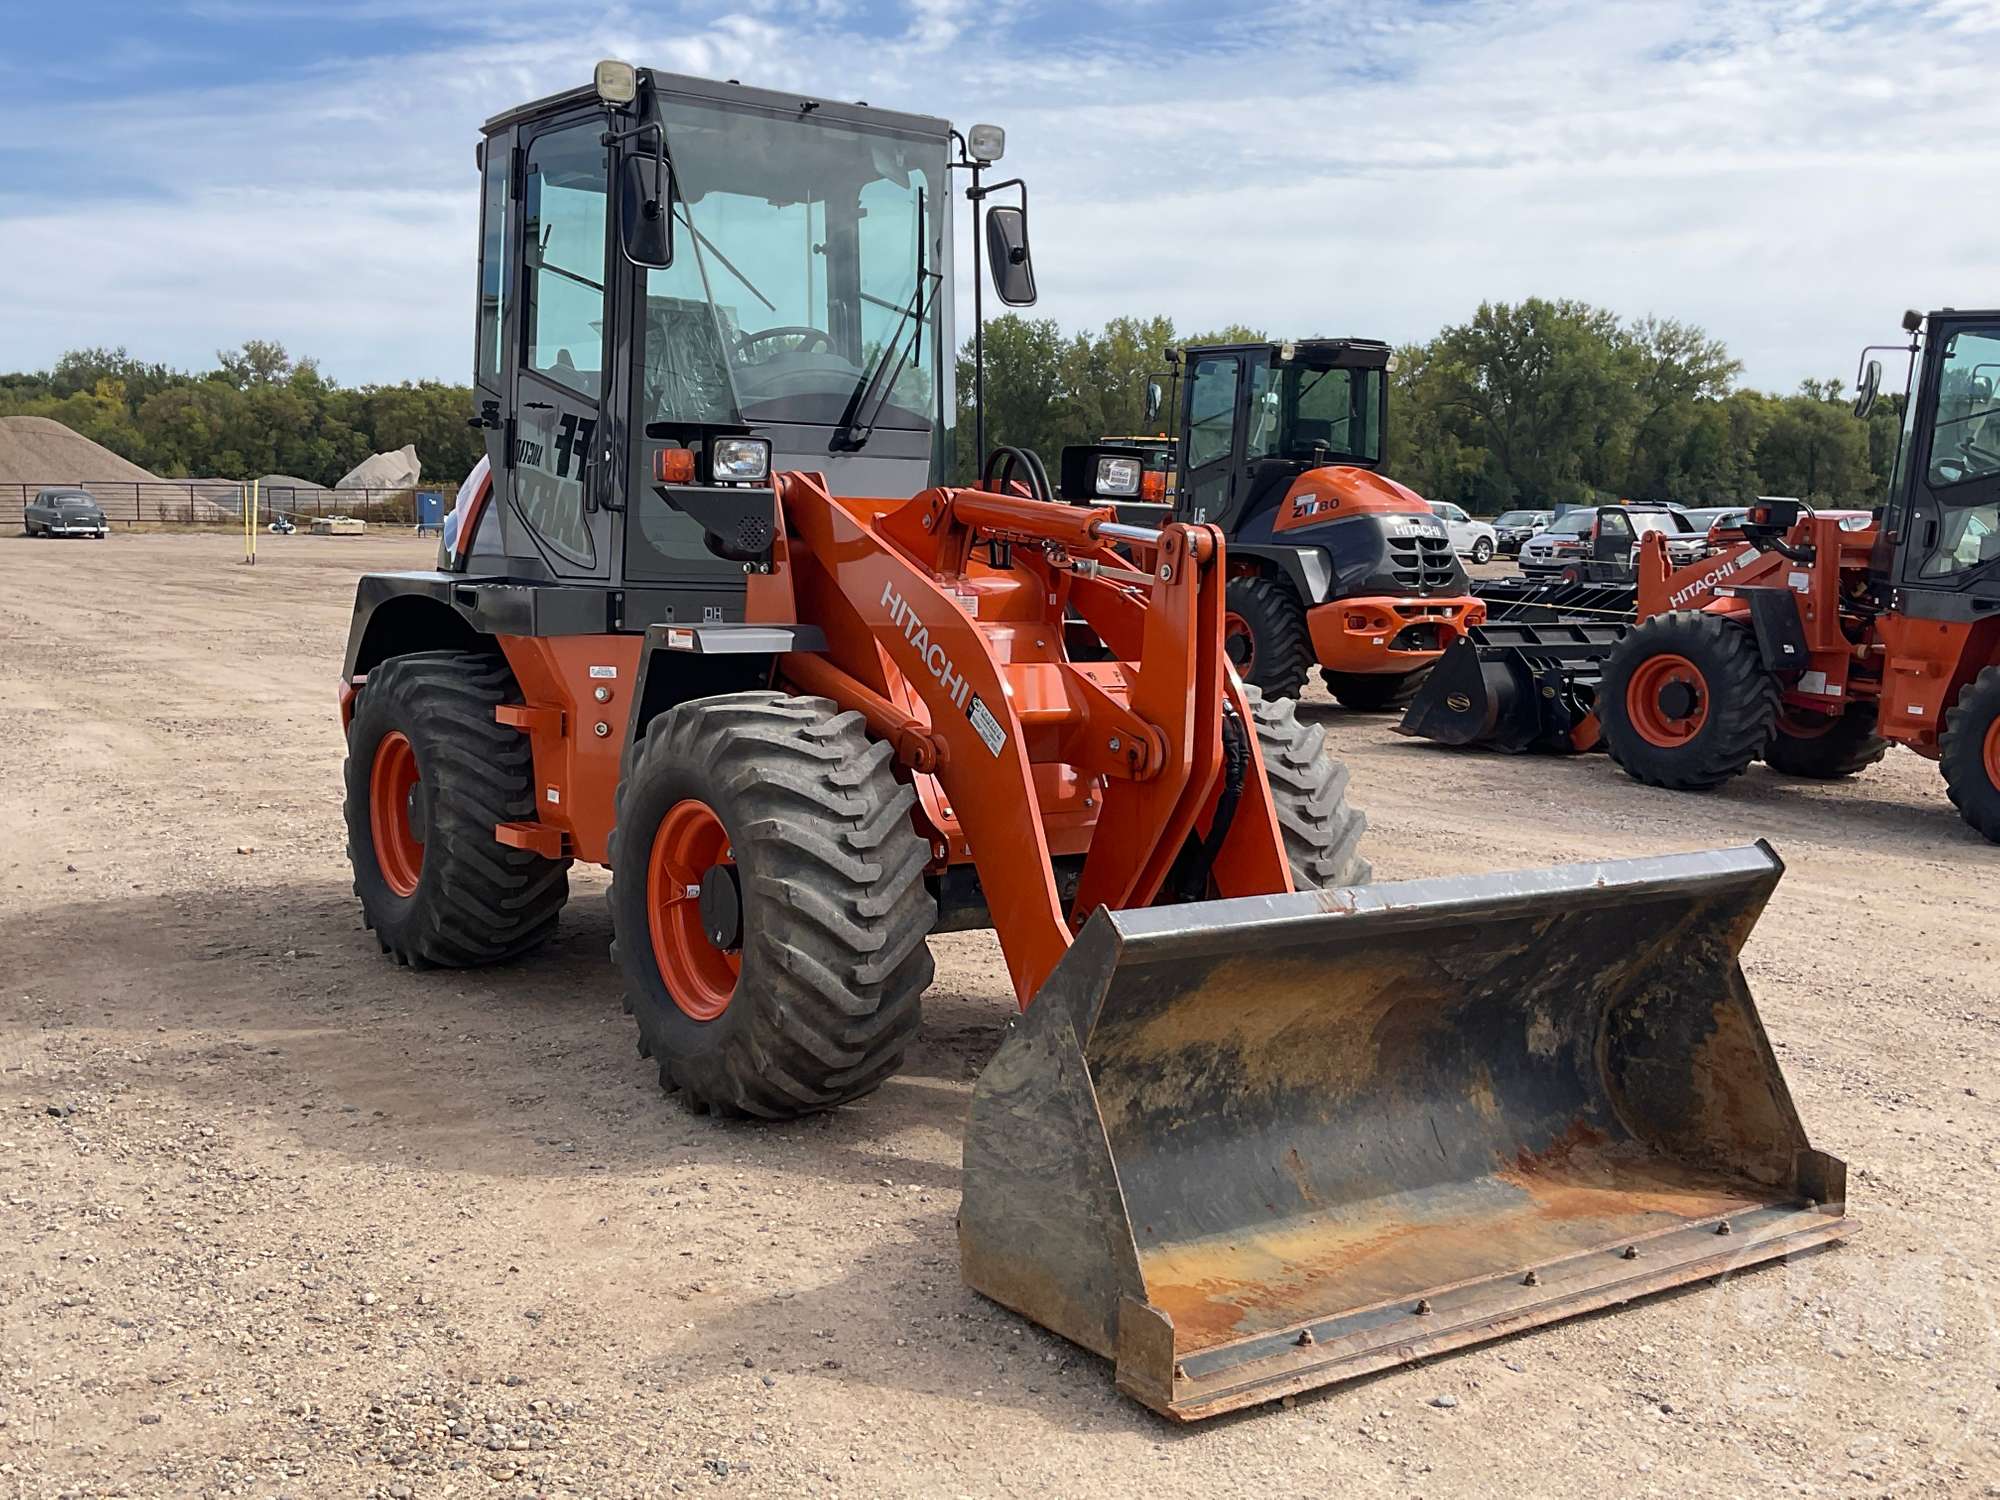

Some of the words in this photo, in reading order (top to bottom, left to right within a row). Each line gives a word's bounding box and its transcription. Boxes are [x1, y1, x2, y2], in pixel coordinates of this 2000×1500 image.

[1395, 524, 1441, 537] HITACHI
[1669, 561, 1735, 608] HITACHI
[881, 581, 970, 709] HITACHI
